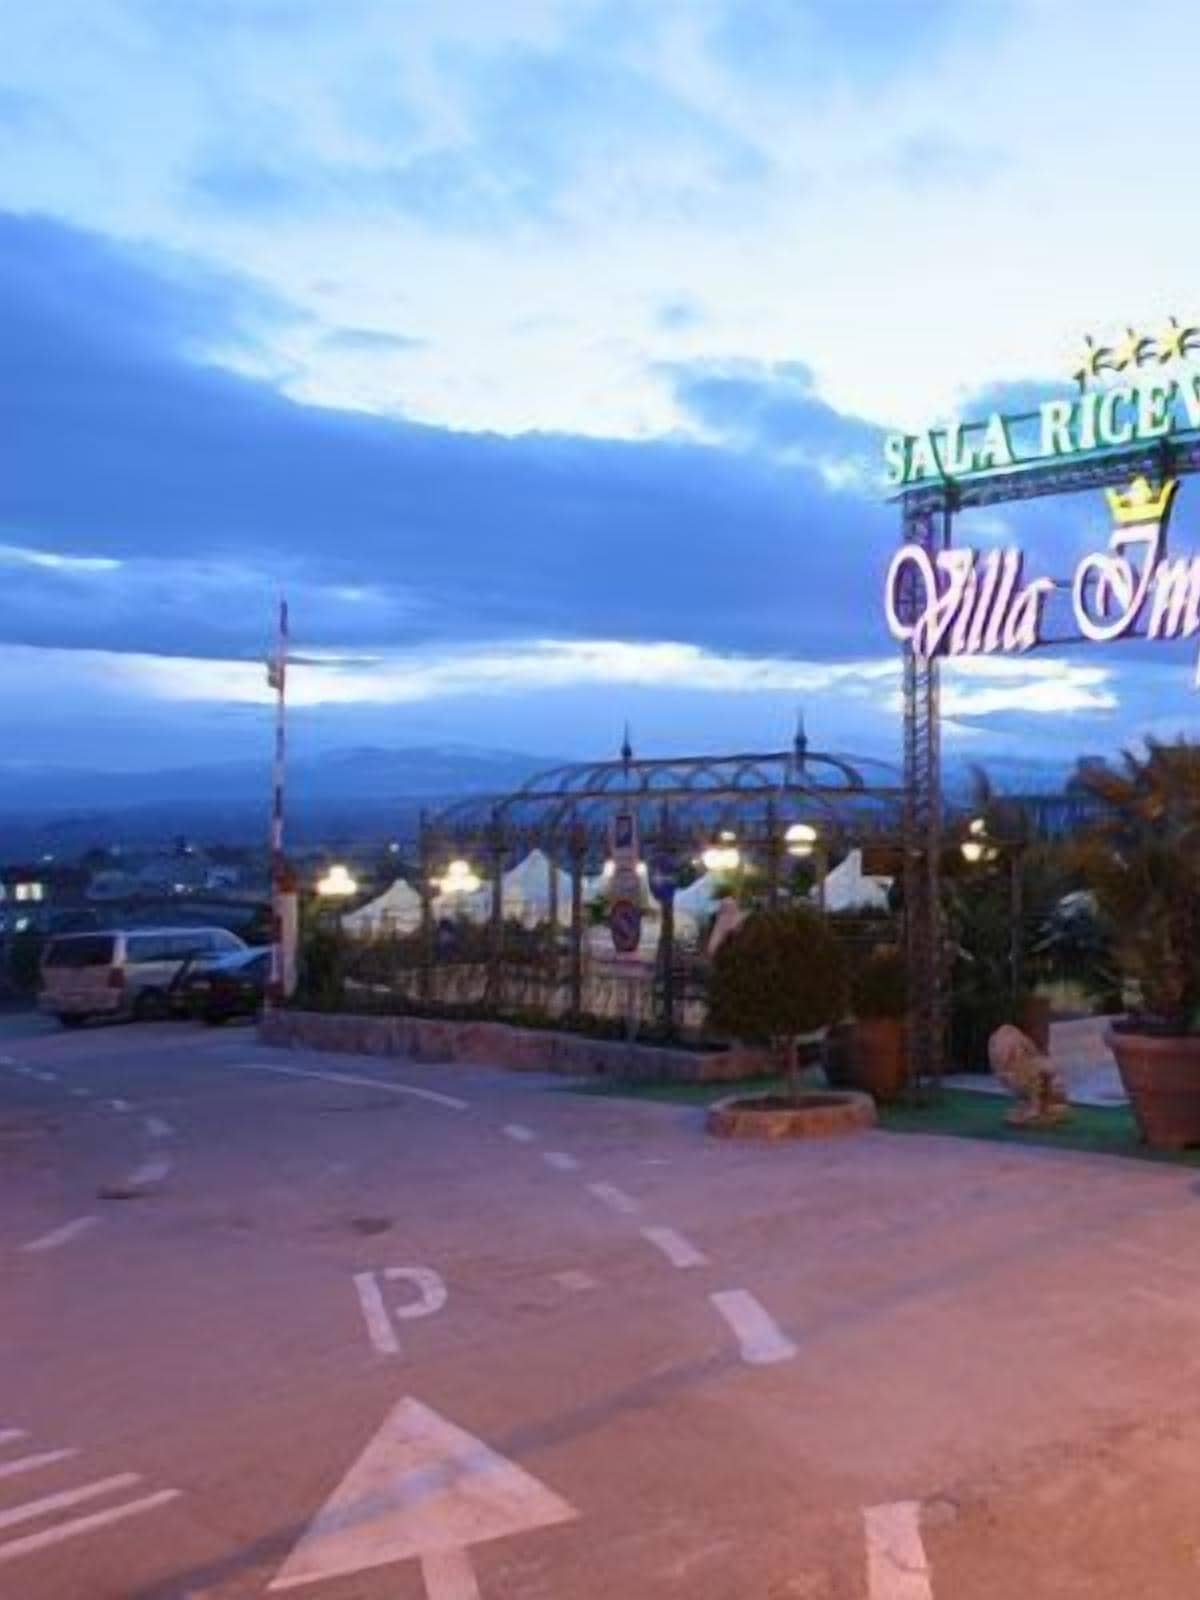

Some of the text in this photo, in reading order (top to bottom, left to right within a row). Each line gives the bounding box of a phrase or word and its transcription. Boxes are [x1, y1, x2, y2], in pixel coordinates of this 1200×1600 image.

[884, 412, 1014, 484] SALA
[885, 545, 1056, 660] Villa
[353, 1267, 447, 1352] P
